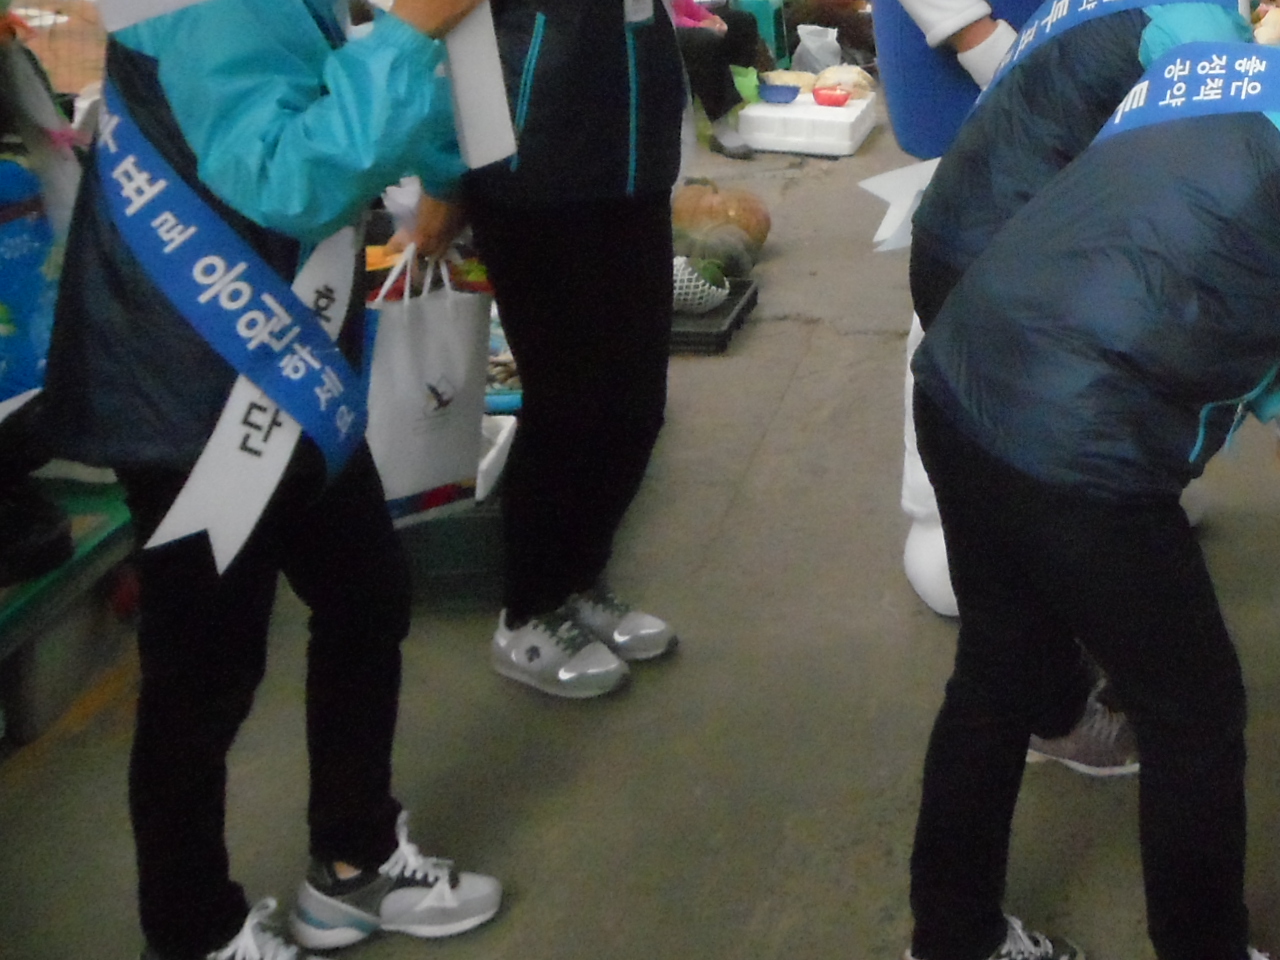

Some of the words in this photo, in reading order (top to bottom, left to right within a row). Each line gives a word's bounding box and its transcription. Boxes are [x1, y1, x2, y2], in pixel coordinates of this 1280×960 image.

[1159, 58, 1190, 107] 공약
[1193, 54, 1227, 101] 정책
[1230, 56, 1267, 100] 좋은
